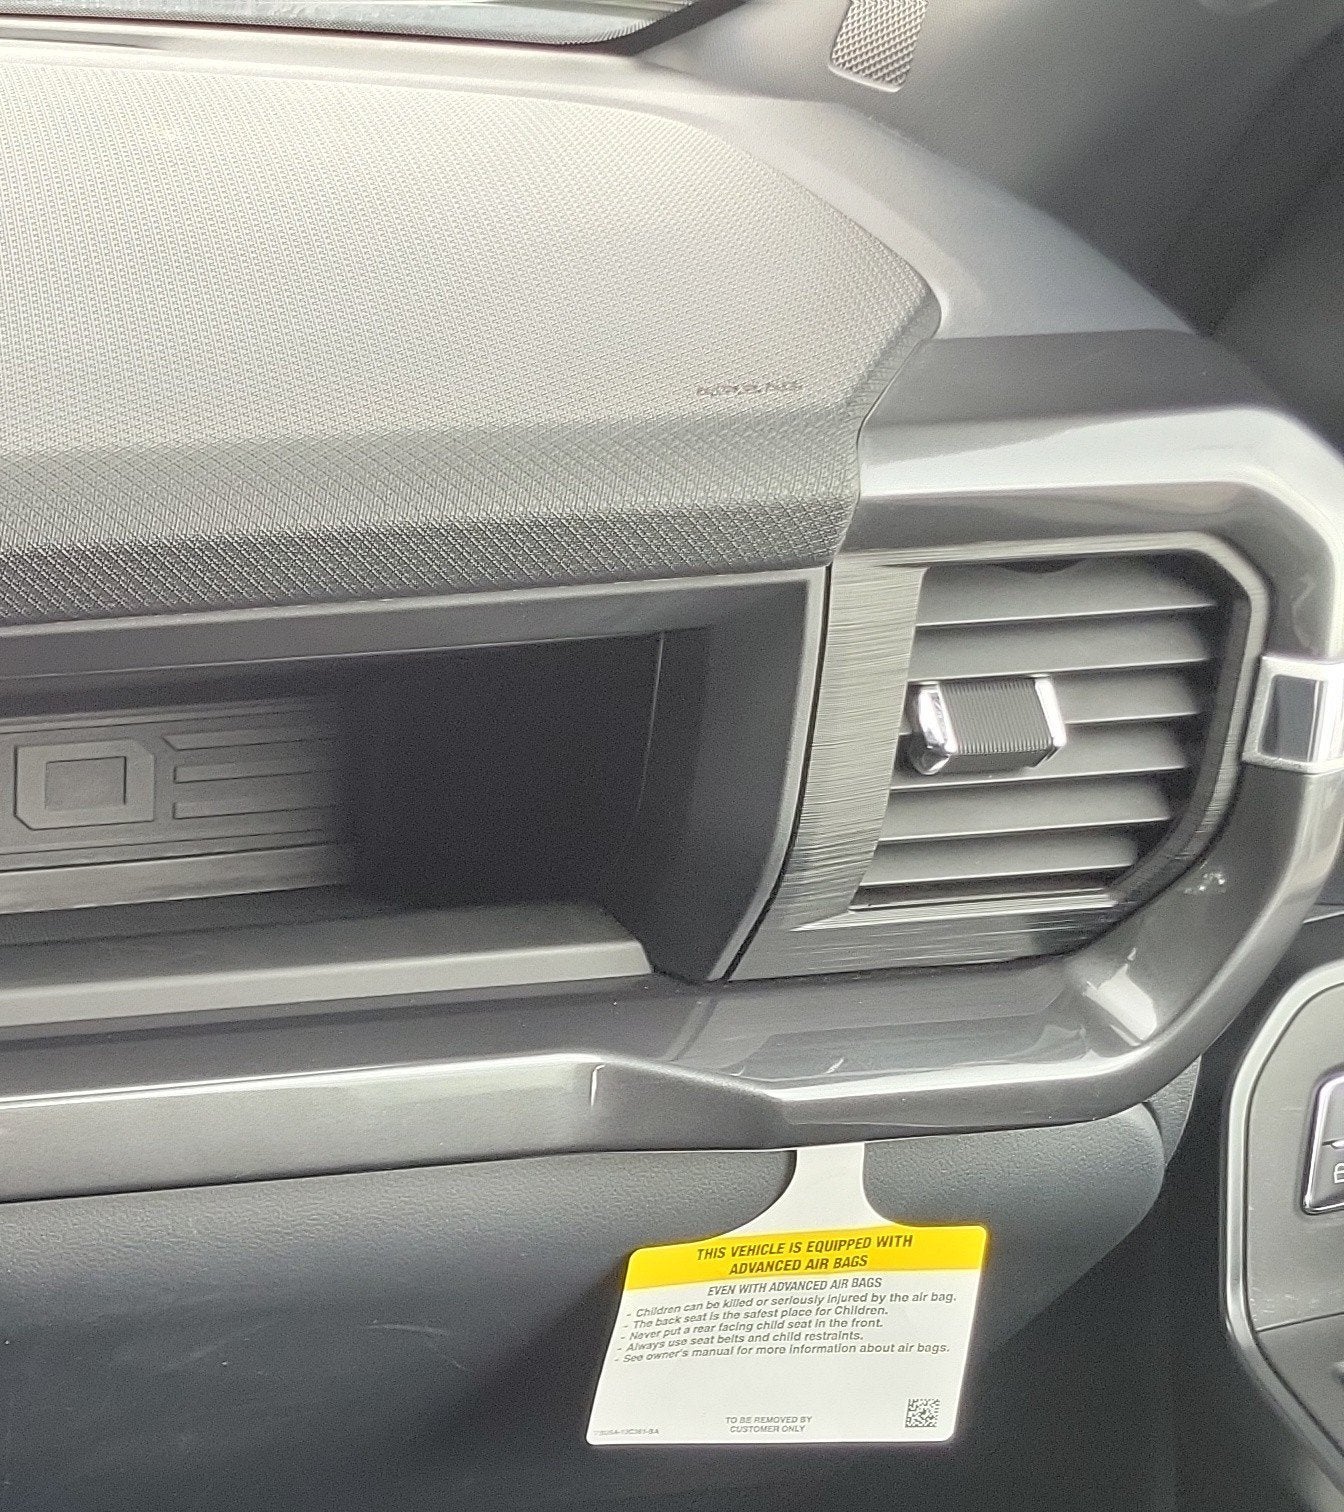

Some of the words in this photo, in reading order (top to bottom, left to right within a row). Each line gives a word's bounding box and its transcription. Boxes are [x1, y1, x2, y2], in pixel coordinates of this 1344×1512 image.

[698, 1247, 726, 1260] THIS
[731, 1243, 785, 1257] VEHICLE
[790, 1242, 802, 1253] IS
[806, 1238, 871, 1253] EQUIPPED
[876, 1235, 913, 1248] WITH
[729, 1259, 801, 1275] ADVANCED
[805, 1258, 828, 1270] AIR
[834, 1255, 868, 1268] BAGS
[708, 1286, 736, 1296] EVEN
[739, 1283, 767, 1294] WITH
[769, 1281, 827, 1292] ADVANCED
[830, 1279, 848, 1289] AIR
[852, 1277, 882, 1288] BAGS
[636, 1305, 681, 1318] Children
[684, 1302, 703, 1312] can
[707, 1300, 719, 1310] be
[723, 1297, 753, 1308] killed
[757, 1298, 768, 1306] or
[771, 1295, 824, 1306] seriously
[827, 1293, 867, 1304] injured
[871, 1293, 886, 1303] by
[889, 1293, 909, 1302] the
[912, 1292, 928, 1302] air
[931, 1292, 956, 1303] bag.
[633, 1320, 653, 1329] The
[655, 1316, 681, 1327] back
[684, 1313, 707, 1323] seat
[709, 1311, 719, 1320] is
[723, 1310, 740, 1319] the
[743, 1309, 779, 1320] safest
[781, 1308, 812, 1319] place
[815, 1307, 831, 1316] for
[835, 1306, 888, 1315] Children.
[630, 1331, 661, 1341] Never
[663, 1327, 681, 1338] put
[683, 1327, 690, 1335] a
[693, 1325, 716, 1334] rear
[719, 1322, 753, 1333] facing
[756, 1321, 784, 1330] child
[787, 1320, 813, 1329] seat
[815, 1319, 825, 1328] in
[829, 1319, 848, 1327] the
[852, 1318, 883, 1327] front.
[626, 1341, 665, 1351] Always
[668, 1339, 687, 1347] use
[690, 1336, 714, 1345] seat
[718, 1334, 744, 1344] belts
[748, 1333, 773, 1342] and
[774, 1332, 801, 1341] child
[805, 1331, 863, 1340] restraints.
[623, 1354, 643, 1363] See
[646, 1348, 688, 1361] owner's
[691, 1348, 733, 1357] manual
[737, 1346, 752, 1355] for
[756, 1346, 785, 1355] more
[789, 1344, 856, 1354] information
[860, 1343, 894, 1353] about
[898, 1343, 914, 1352] air
[917, 1343, 949, 1354] bags.
[730, 1425, 779, 1433] CUSTOMER
